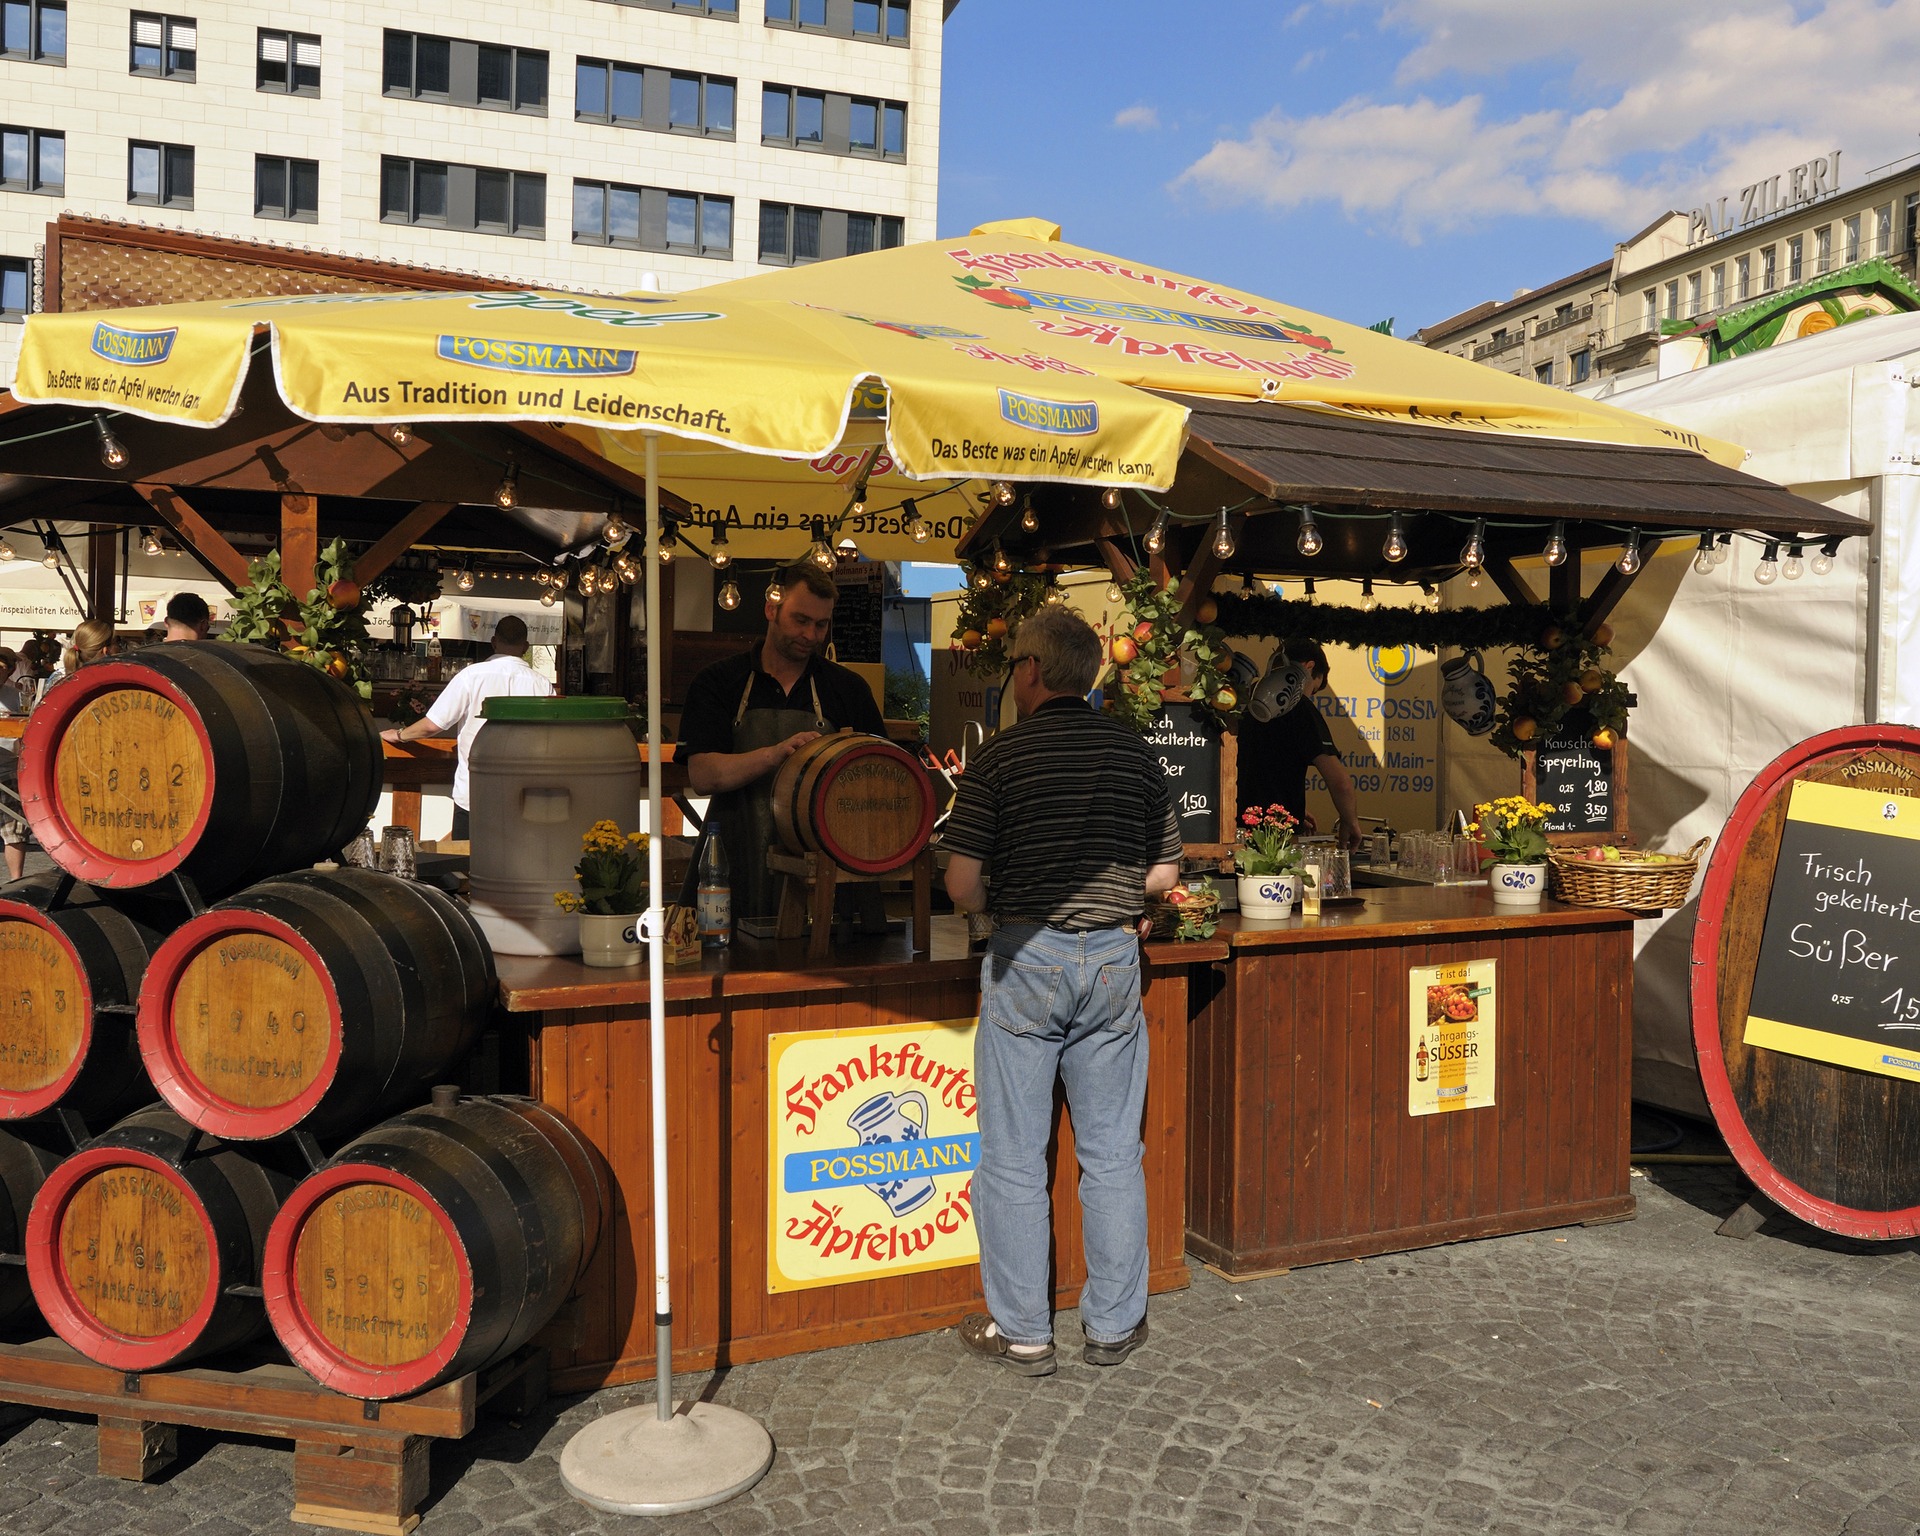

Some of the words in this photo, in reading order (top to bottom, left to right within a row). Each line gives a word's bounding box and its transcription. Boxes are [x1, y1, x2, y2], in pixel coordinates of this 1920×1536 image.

[1686, 196, 1734, 246] PAL
[1739, 150, 1842, 226] ZILERI
[946, 248, 1285, 320] Frankfurter
[1029, 293, 1279, 341] POSSMANN
[97, 327, 169, 359] POSSMANN
[452, 336, 620, 371] POSSMANN
[47, 370, 58, 389] Das
[58, 369, 82, 390] Beste
[84, 375, 101, 392] was
[102, 373, 117, 394] ein
[118, 375, 146, 401] Apfel
[147, 384, 181, 407] werden
[342, 380, 390, 405] Aus
[396, 380, 508, 407] Tradition
[518, 387, 563, 409] und
[573, 389, 732, 433] Leidenschaft.
[1006, 395, 1093, 430] POSSMANN
[931, 438, 958, 459] Das
[962, 439, 999, 460] Beste
[1003, 446, 1026, 461] was
[1029, 443, 1047, 463] ein
[1049, 445, 1081, 470] Apfel
[1081, 454, 1114, 472] werden
[1117, 458, 1155, 477] kann.
[92, 692, 176, 725] POSSMANN
[958, 690, 983, 708] vom
[1357, 725, 1382, 741] Seit
[1386, 726, 1416, 742] 1881
[1158, 756, 1186, 777] ßer
[1538, 752, 1602, 777] Speyerling
[1841, 760, 1914, 782] POSSMANN
[1178, 791, 1208, 812] 1,50
[1558, 783, 1575, 794] 0,25
[1584, 779, 1608, 795] 1,80
[1544, 821, 1565, 832] Pfand
[1558, 802, 1572, 814] 0,5
[1584, 802, 1608, 818] 3,50
[218, 942, 305, 980] POSSMANN
[1788, 923, 1899, 972] Süßer
[1435, 970, 1443, 979] Er
[1446, 969, 1456, 979] ist
[1458, 967, 1471, 978] da!
[1430, 1030, 1479, 1043] Jahrgangs-
[1430, 1043, 1479, 1062] SÜSSER
[1888, 1057, 1920, 1070] POSSMA
[785, 1042, 978, 1137] Frankfurte
[810, 1141, 972, 1182] POSSMANN
[100, 1176, 181, 1217] POSSMANN
[335, 1190, 424, 1225] POSSMANN
